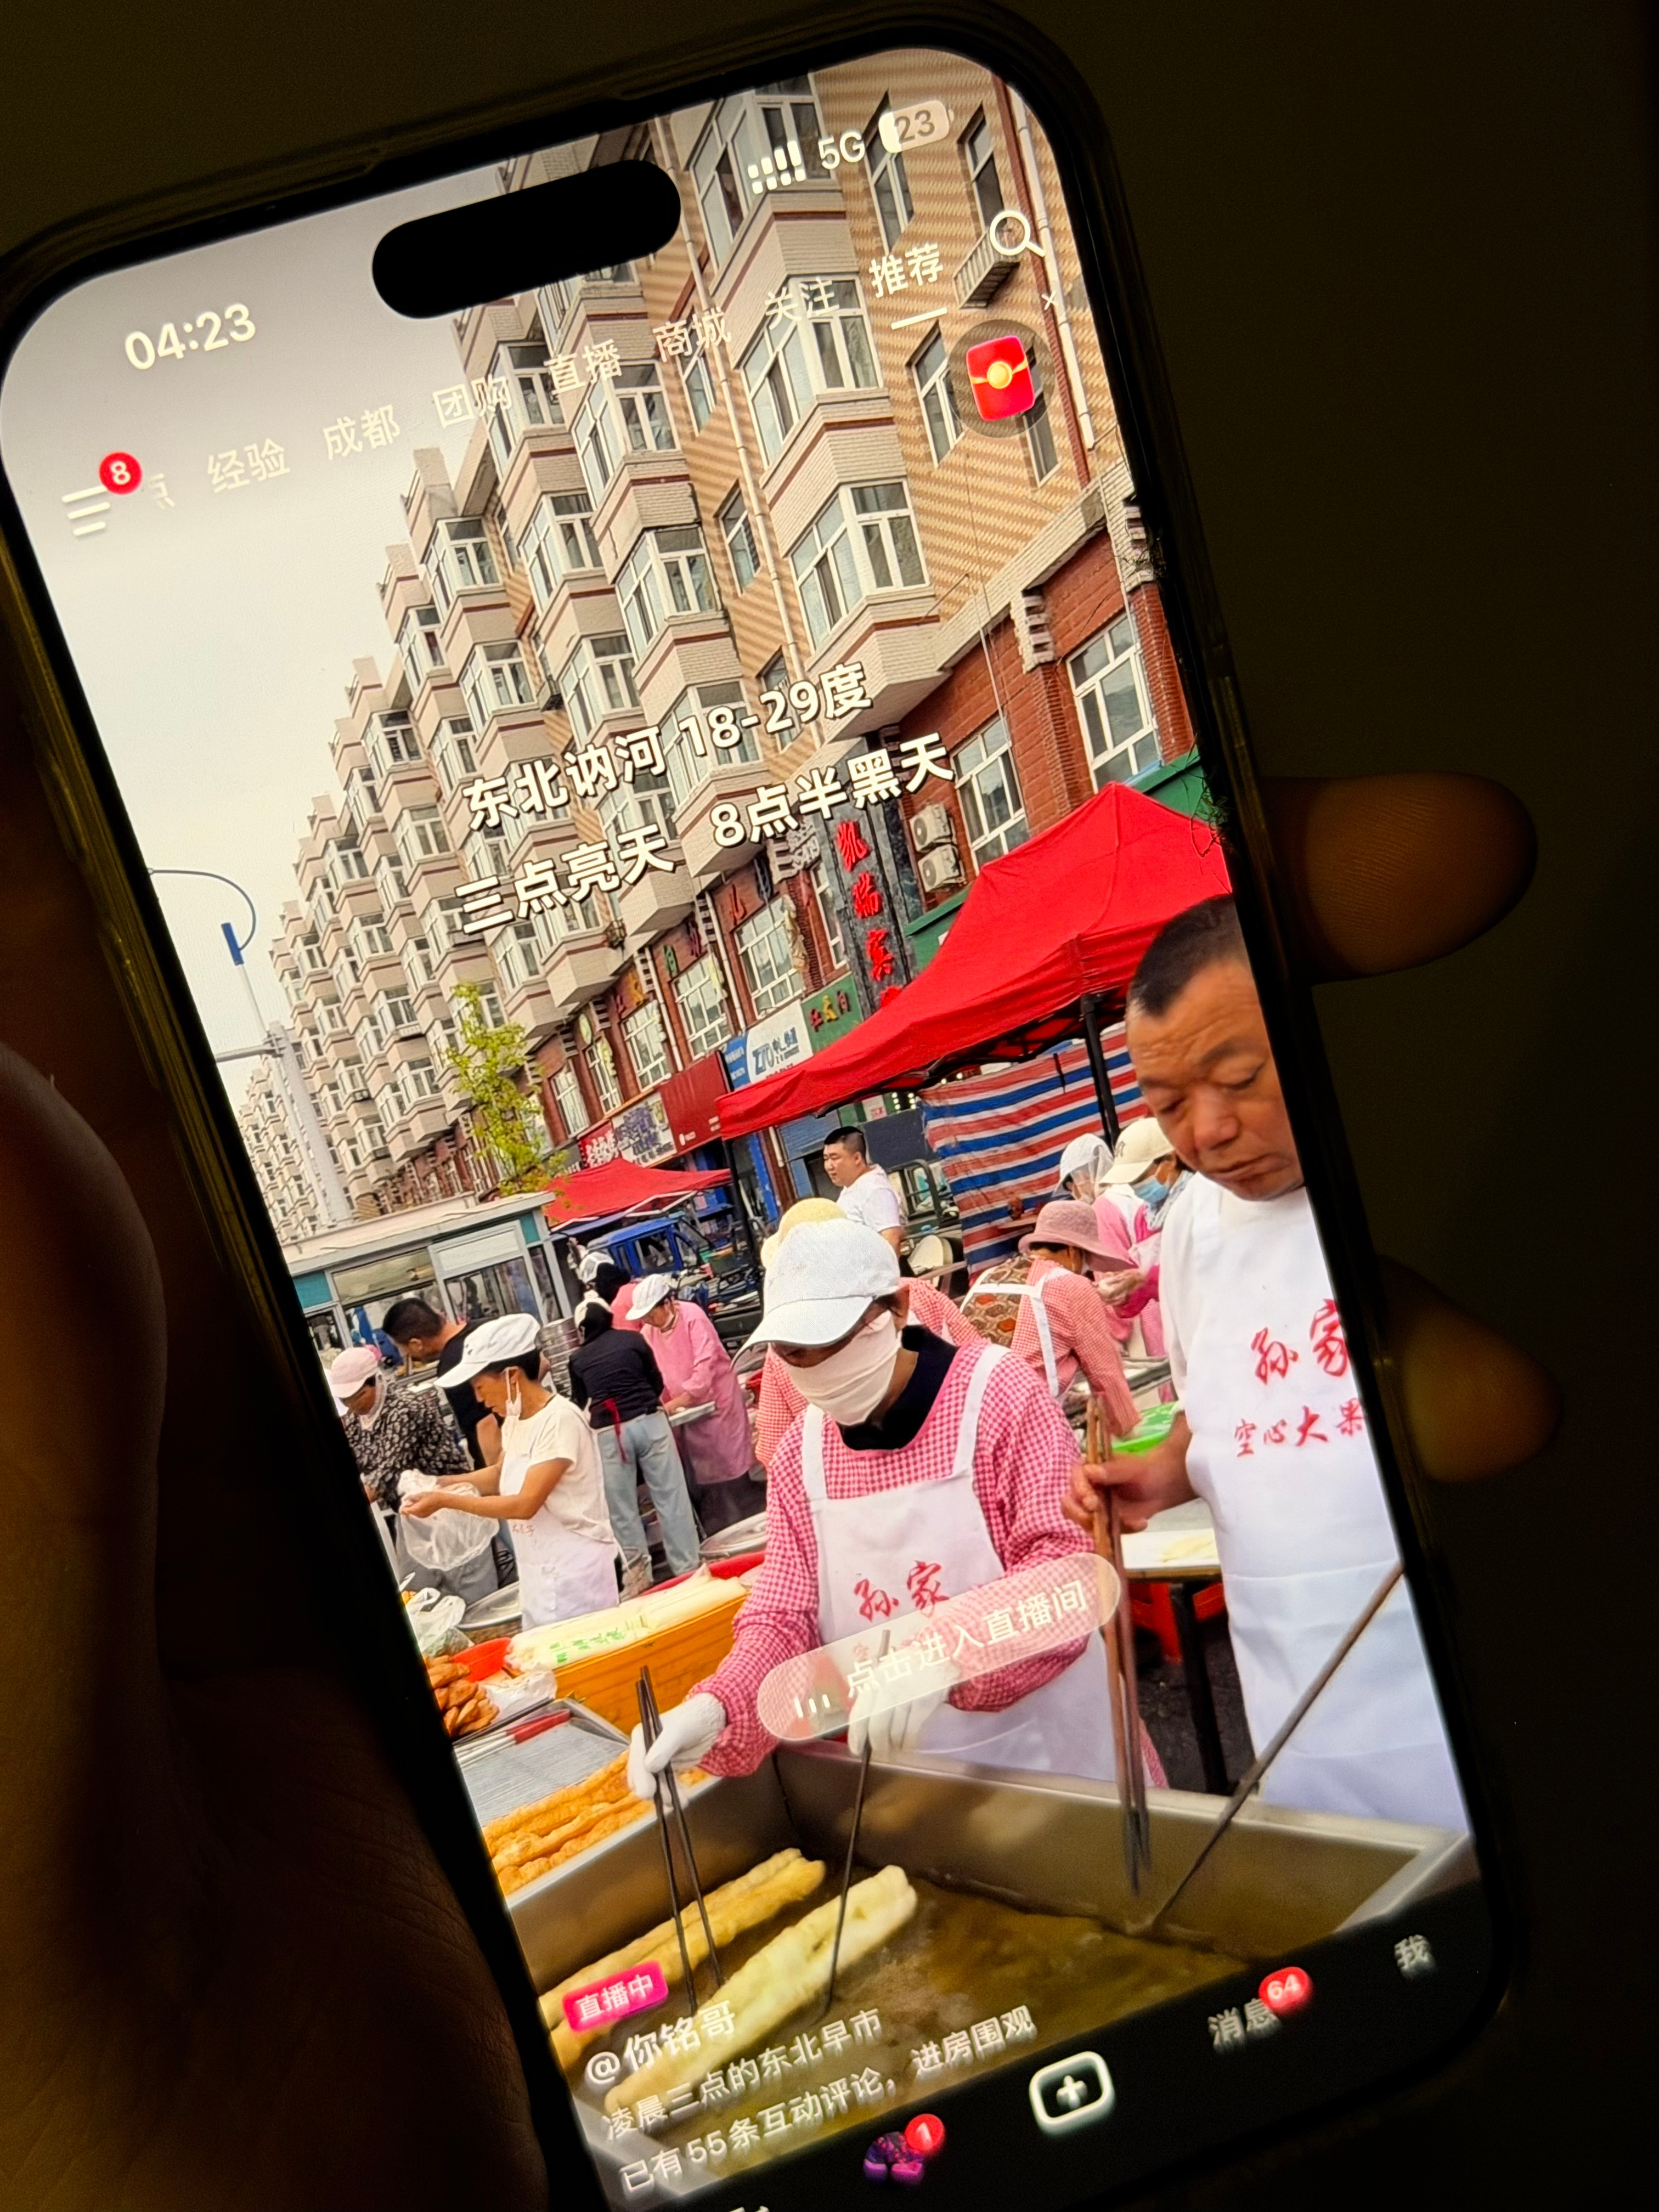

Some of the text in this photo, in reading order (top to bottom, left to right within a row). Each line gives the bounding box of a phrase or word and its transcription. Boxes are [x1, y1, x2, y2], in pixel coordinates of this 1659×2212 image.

[818, 110, 936, 170] 5G 23
[125, 303, 256, 370] 04:23
[207, 438, 291, 494] 经验
[322, 404, 401, 460] 成都
[433, 375, 512, 428] 团购
[544, 339, 622, 394] 直播
[653, 307, 731, 363] 商城
[765, 277, 840, 330] 关注
[869, 242, 944, 298] 推荐
[110, 460, 131, 485] 8
[462, 661, 873, 832] 东北讷河 18-29度
[454, 732, 955, 934] 三点亮天 8点半黑天
[854, 1560, 950, 1622] 孙家
[847, 1579, 1087, 1698] 点击进入直播间
[1394, 1934, 1433, 1972] 我
[575, 1973, 654, 2022] 直播中
[1267, 1974, 1301, 2000] 64
[585, 2000, 736, 2085] @你铭哥
[1207, 1997, 1279, 2051] 消息
[602, 2008, 882, 2143] 凌晨三点的东北早市
[916, 2123, 932, 2140] 1
